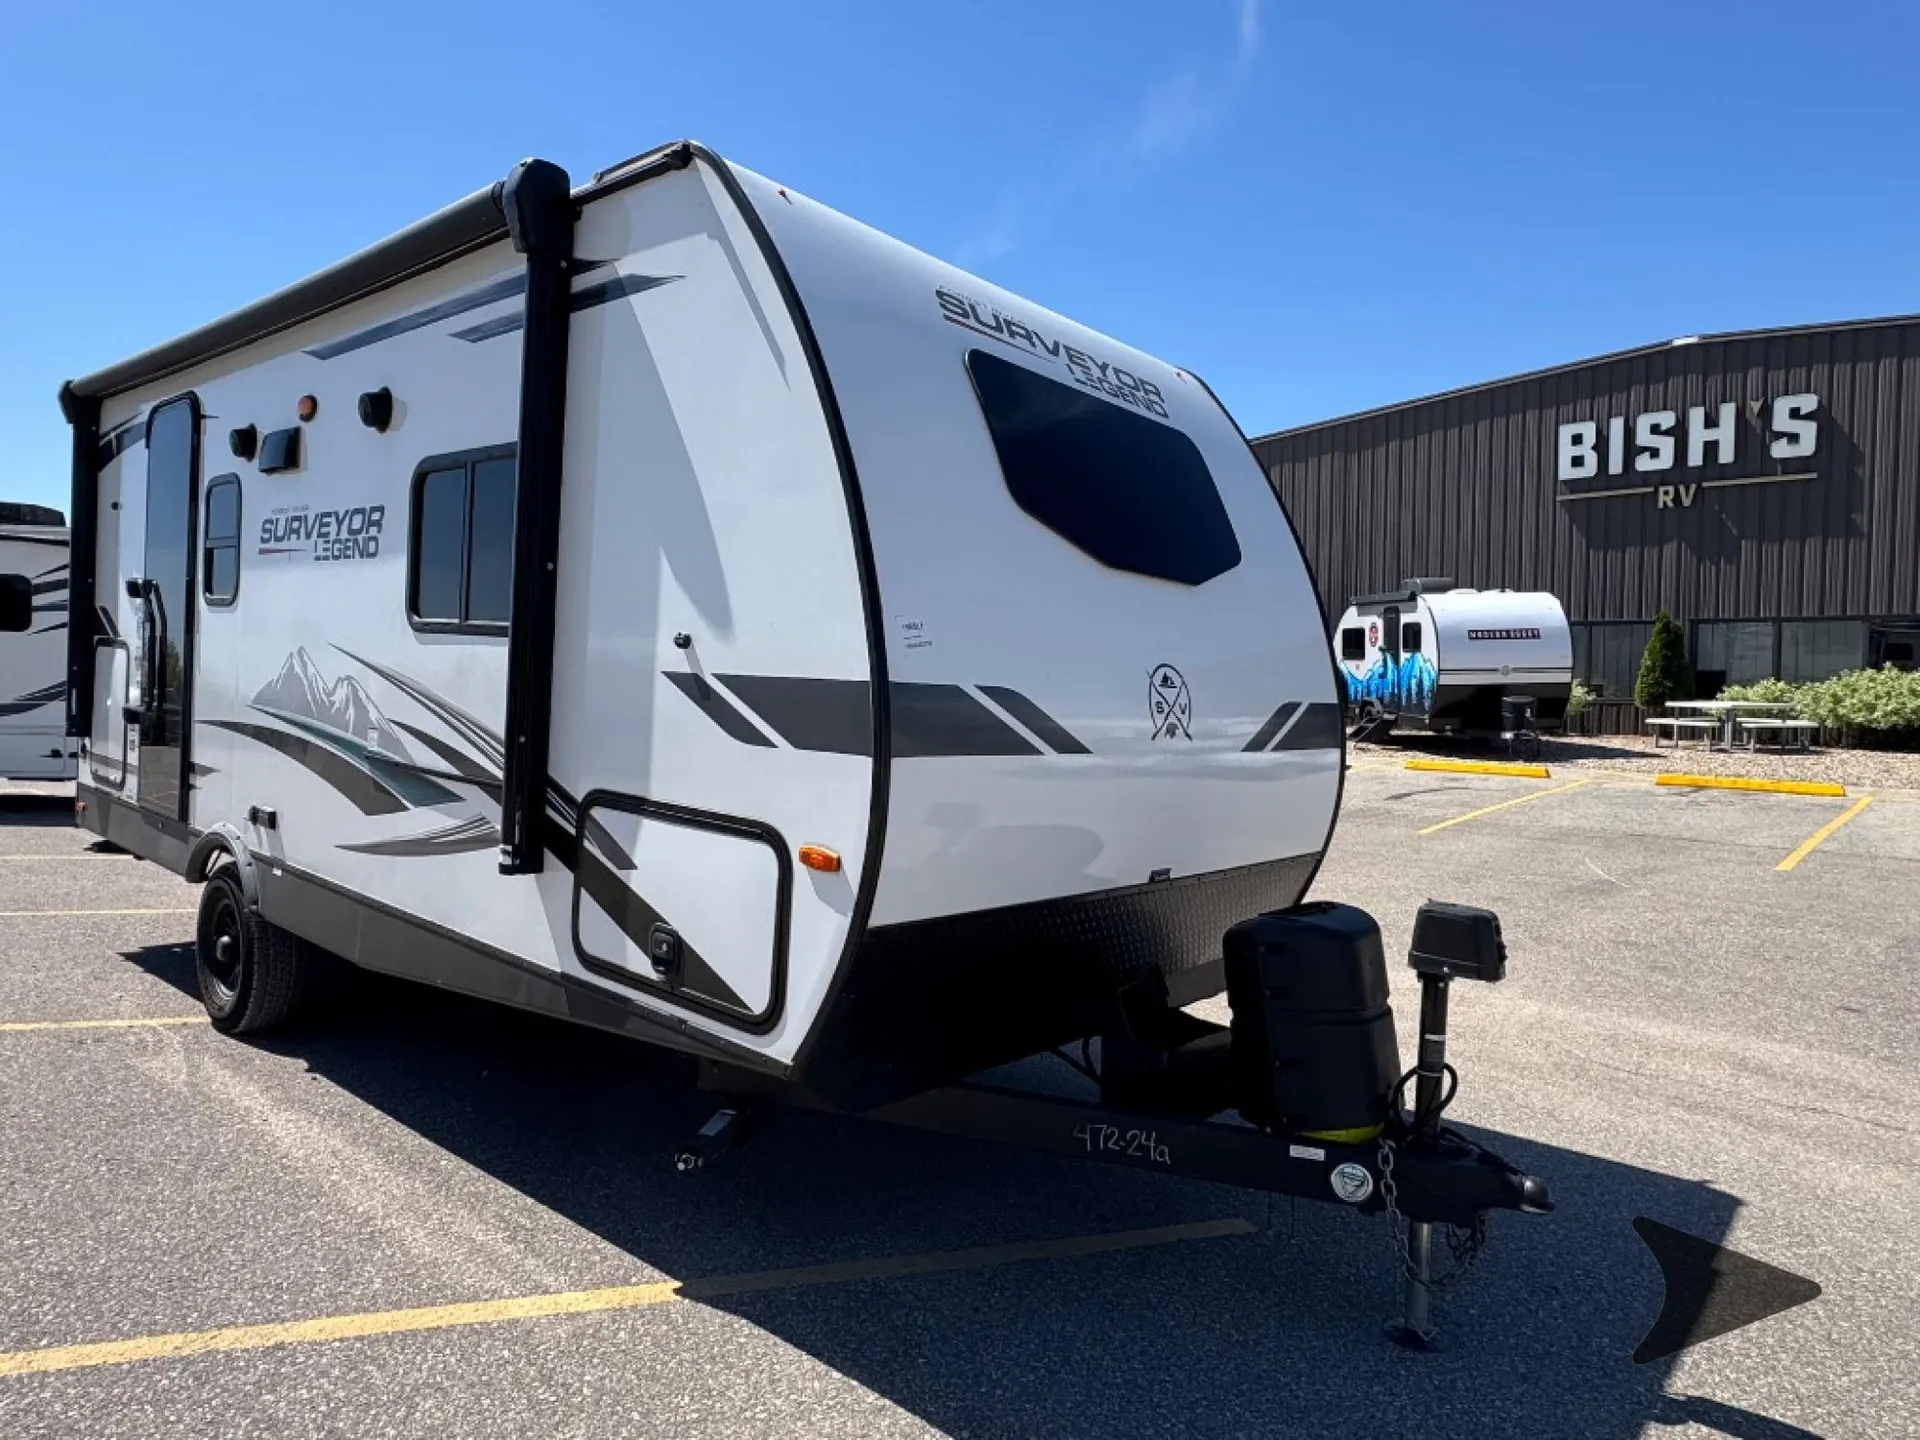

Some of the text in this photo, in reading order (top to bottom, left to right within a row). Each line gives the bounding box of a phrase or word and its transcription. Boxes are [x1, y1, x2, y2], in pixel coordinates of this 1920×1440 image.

[936, 289, 1164, 403] SURVEYOR
[1066, 363, 1169, 419] LEGEND
[1558, 393, 1819, 481] BISH'S
[1656, 483, 1698, 509] RV
[260, 505, 385, 544] SURVEYOR
[314, 535, 380, 561] LEGEND
